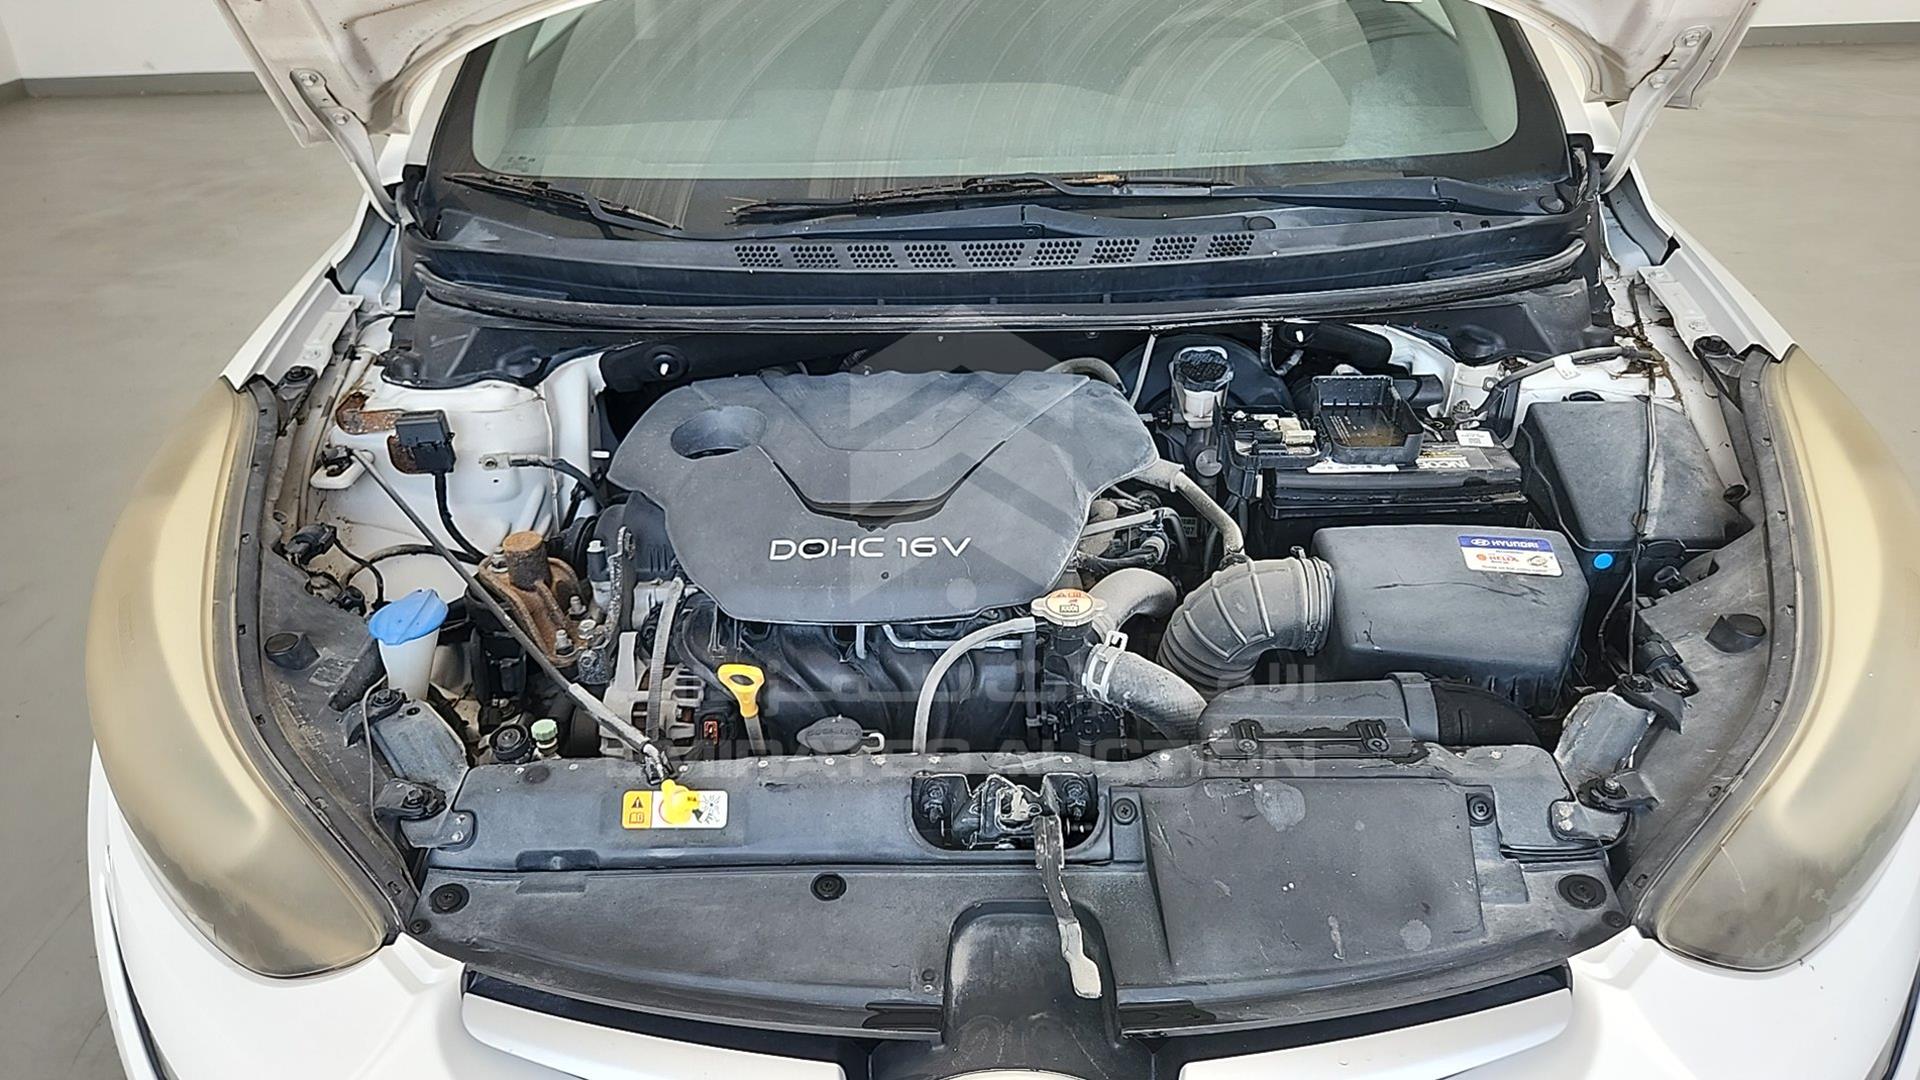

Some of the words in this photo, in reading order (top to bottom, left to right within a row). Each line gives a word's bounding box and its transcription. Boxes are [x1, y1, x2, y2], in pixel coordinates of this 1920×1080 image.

[769, 536, 885, 561] DOHC
[897, 536, 971, 558] 16V
[1491, 539, 1539, 549] HYUNDAI
